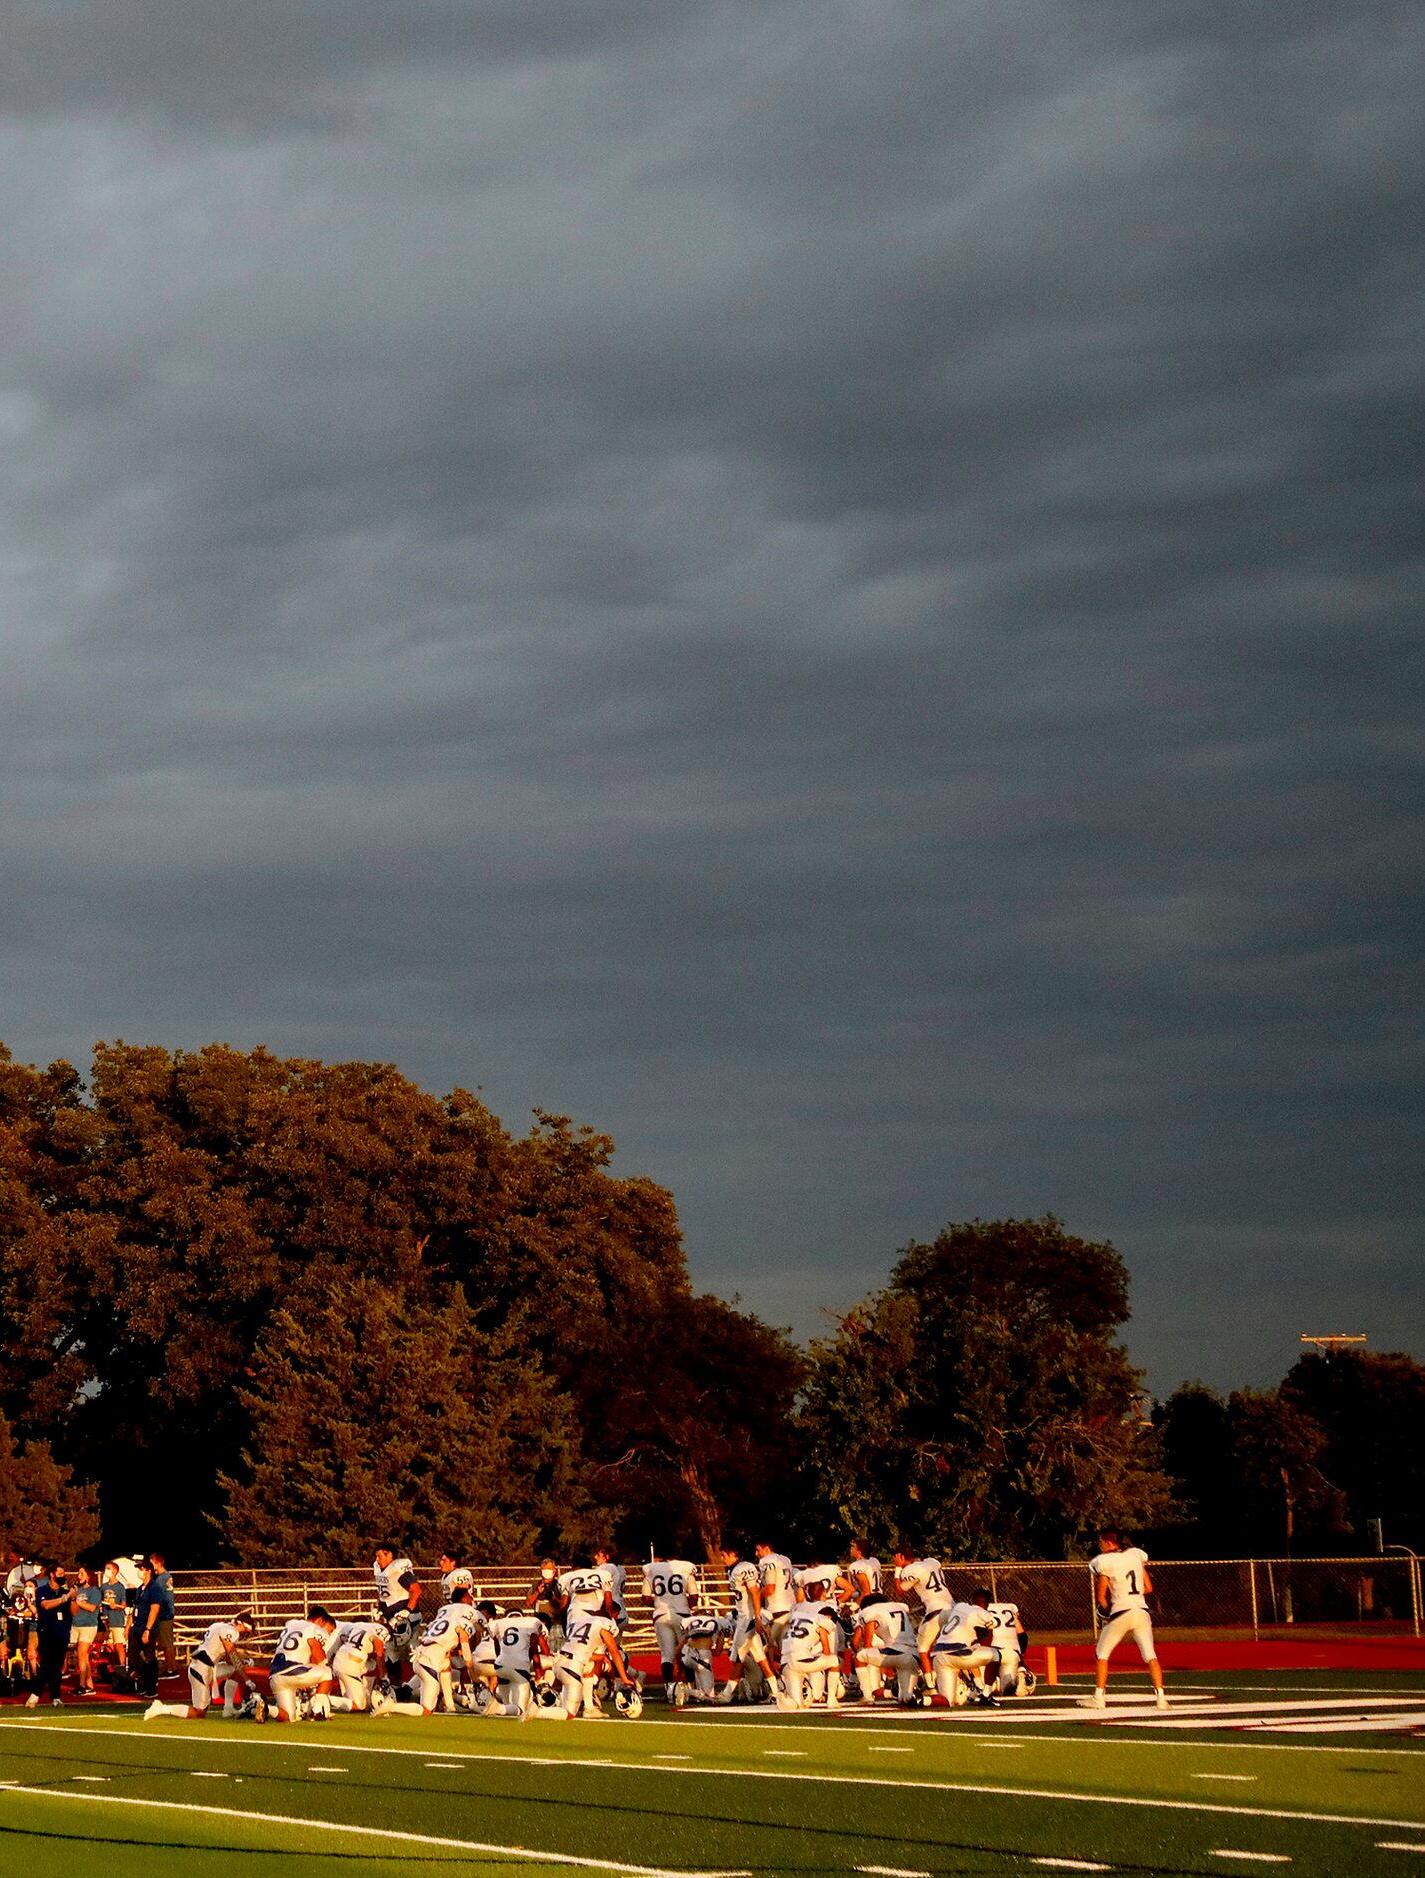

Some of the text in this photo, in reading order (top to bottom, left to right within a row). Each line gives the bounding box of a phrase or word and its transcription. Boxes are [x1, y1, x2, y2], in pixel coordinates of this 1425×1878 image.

[570, 1574, 602, 1591] 23
[652, 1574, 683, 1597] 66
[1125, 1569, 1140, 1595] 1
[890, 1610, 906, 1632] 7
[503, 1626, 520, 1647] 6
